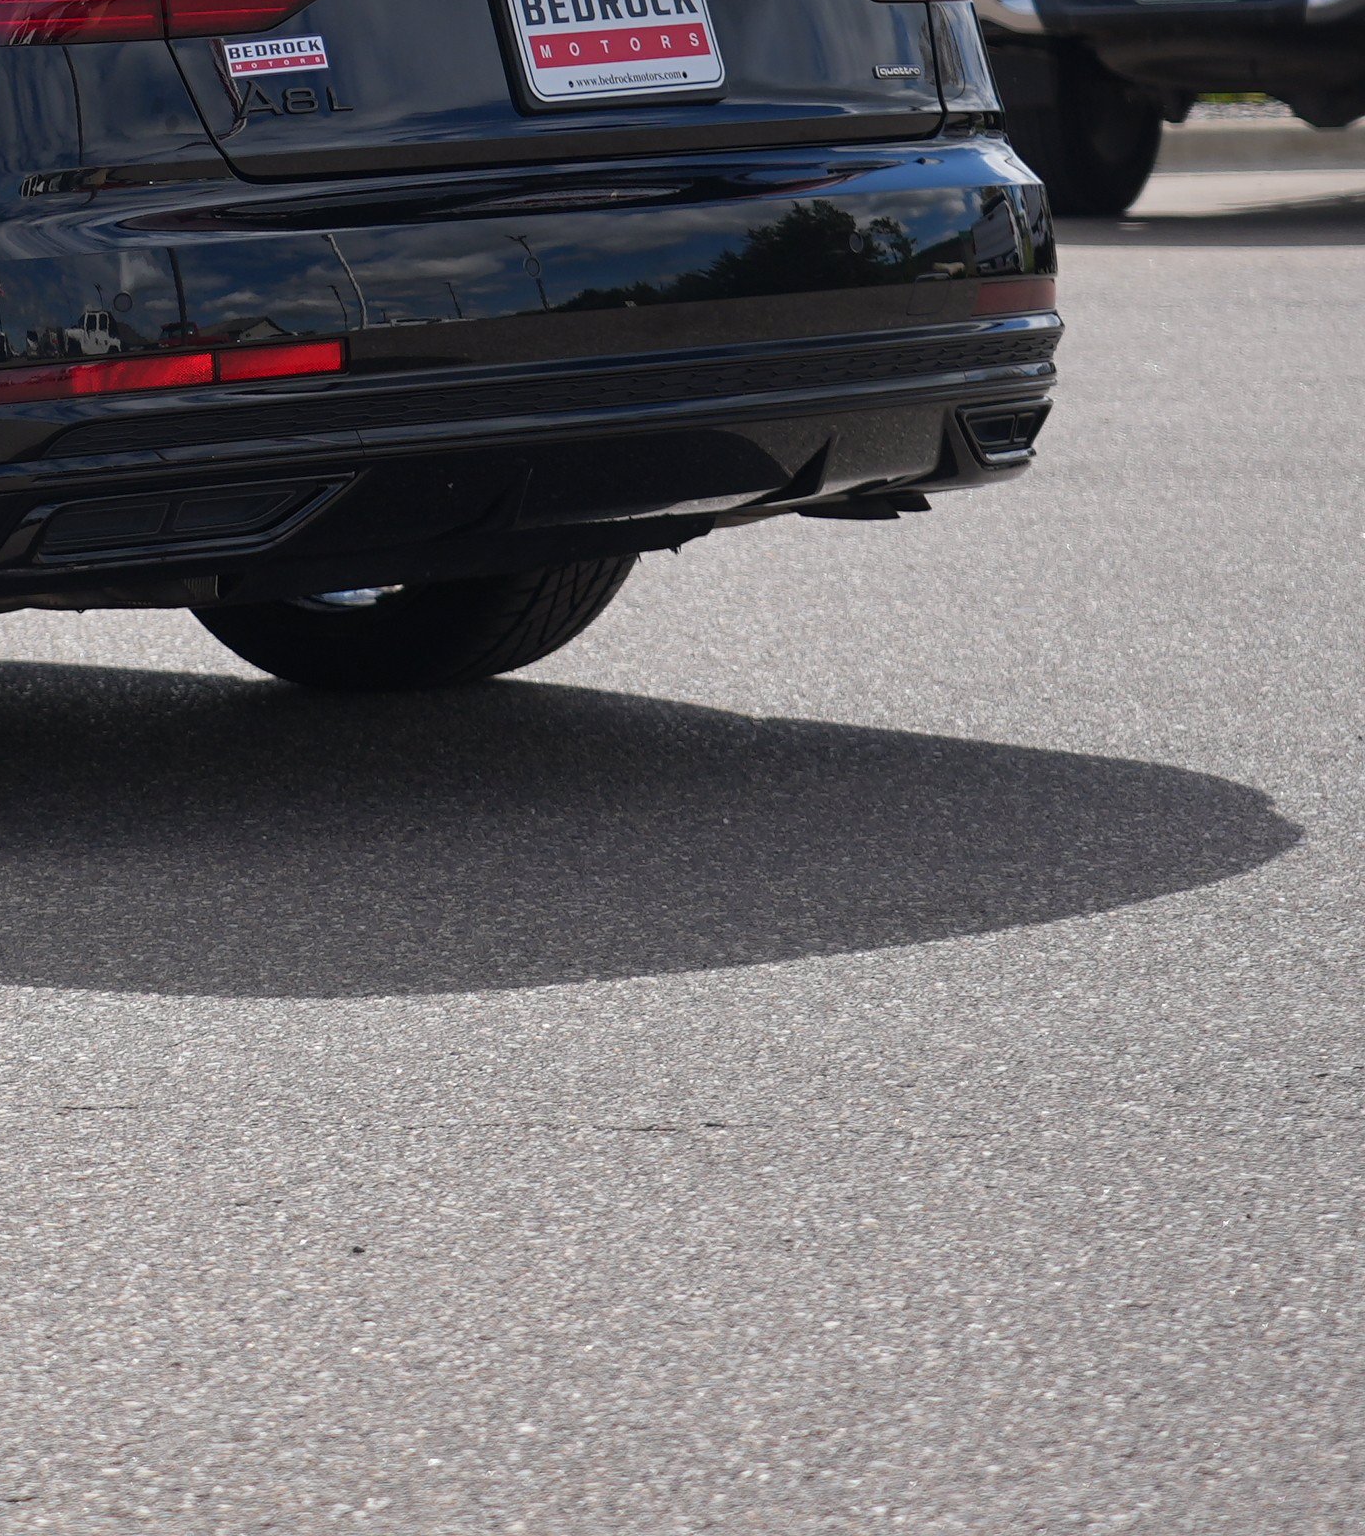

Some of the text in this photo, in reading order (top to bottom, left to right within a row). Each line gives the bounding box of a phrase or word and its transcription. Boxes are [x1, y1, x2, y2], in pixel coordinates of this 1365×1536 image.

[228, 39, 321, 60] BEDROCK
[539, 32, 700, 59] MOTORS
[235, 56, 321, 71] MOTORS
[880, 66, 920, 76] quattro
[576, 70, 682, 88] www.bedrockmotors.com
